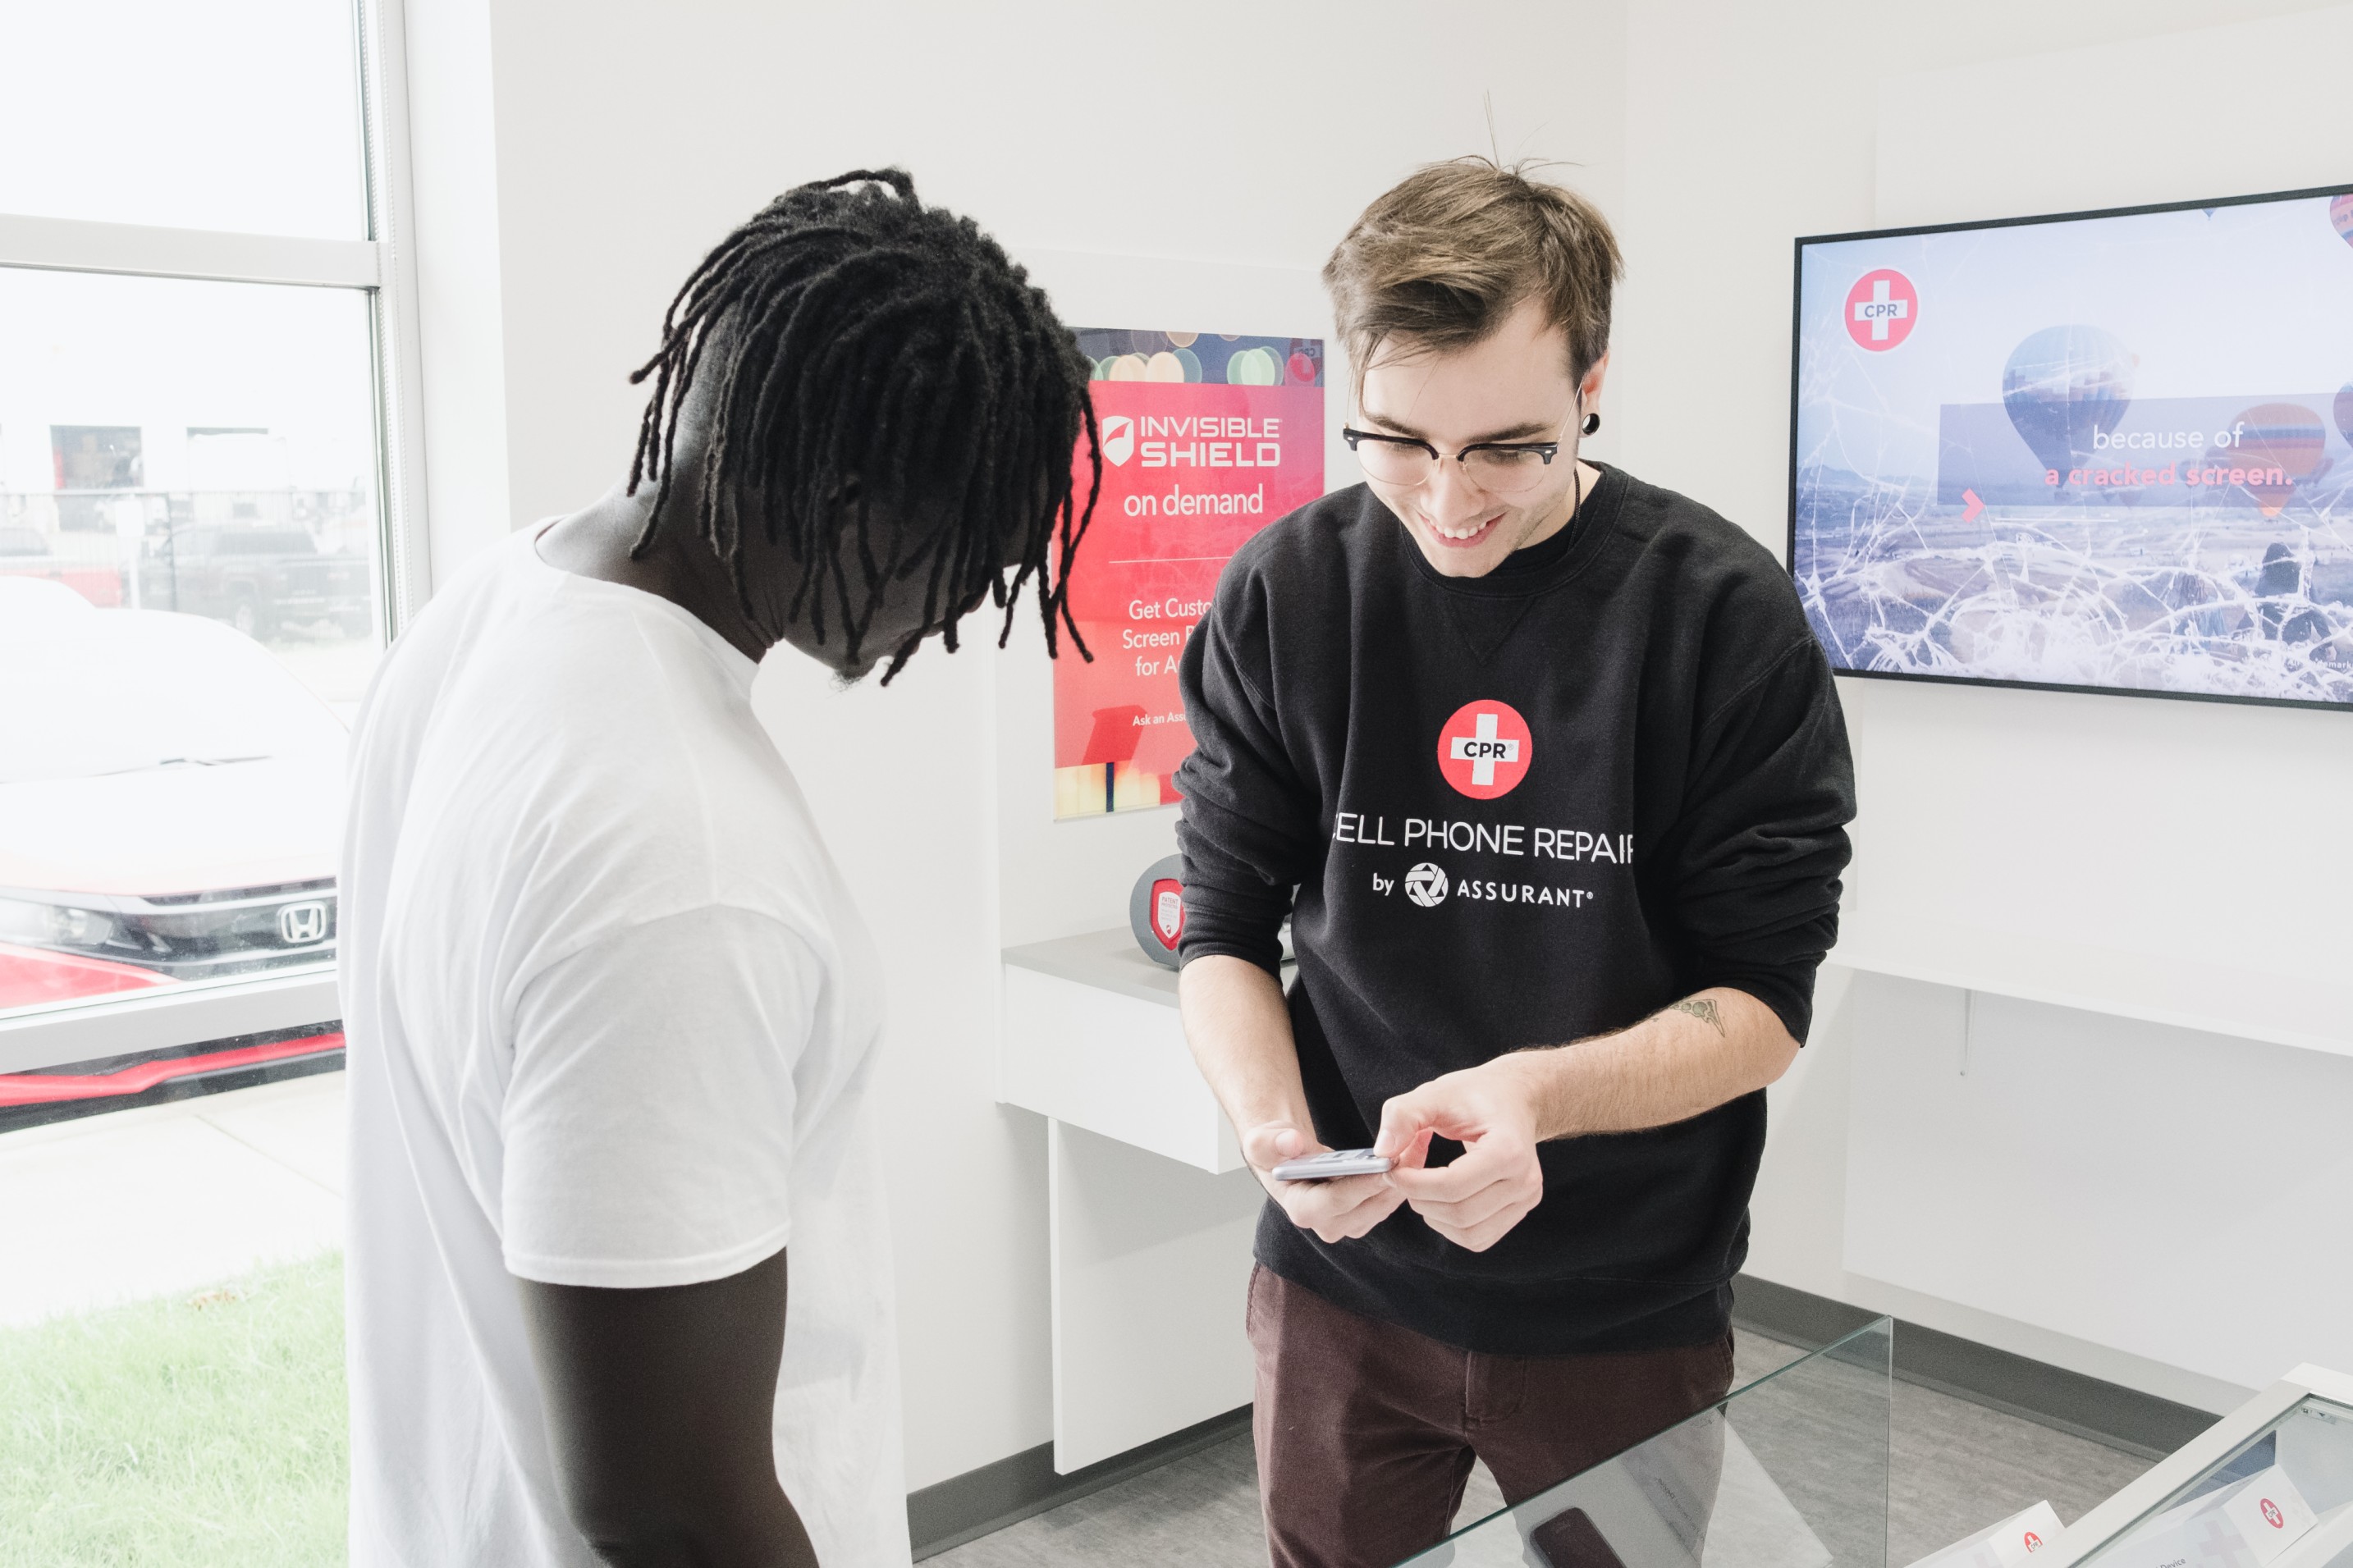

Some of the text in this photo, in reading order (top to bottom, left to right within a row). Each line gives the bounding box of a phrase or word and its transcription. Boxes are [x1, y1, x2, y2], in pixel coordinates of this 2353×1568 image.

[1864, 304, 1898, 318] CPR
[1140, 416, 1280, 439] INVISIBLE
[2093, 421, 2245, 450] because of
[1140, 441, 1281, 468] SHIELD
[2044, 459, 2294, 487] a cracked screen.
[1124, 482, 1264, 517] on demand
[1128, 599, 1161, 620] Get
[1122, 629, 1180, 650] Screen
[1135, 654, 1181, 677] for A
[1133, 713, 1151, 727] Ask
[1152, 715, 1165, 725] an
[1332, 811, 1395, 846] ELL
[1403, 817, 1525, 856] PHONE
[1372, 872, 1395, 897] by
